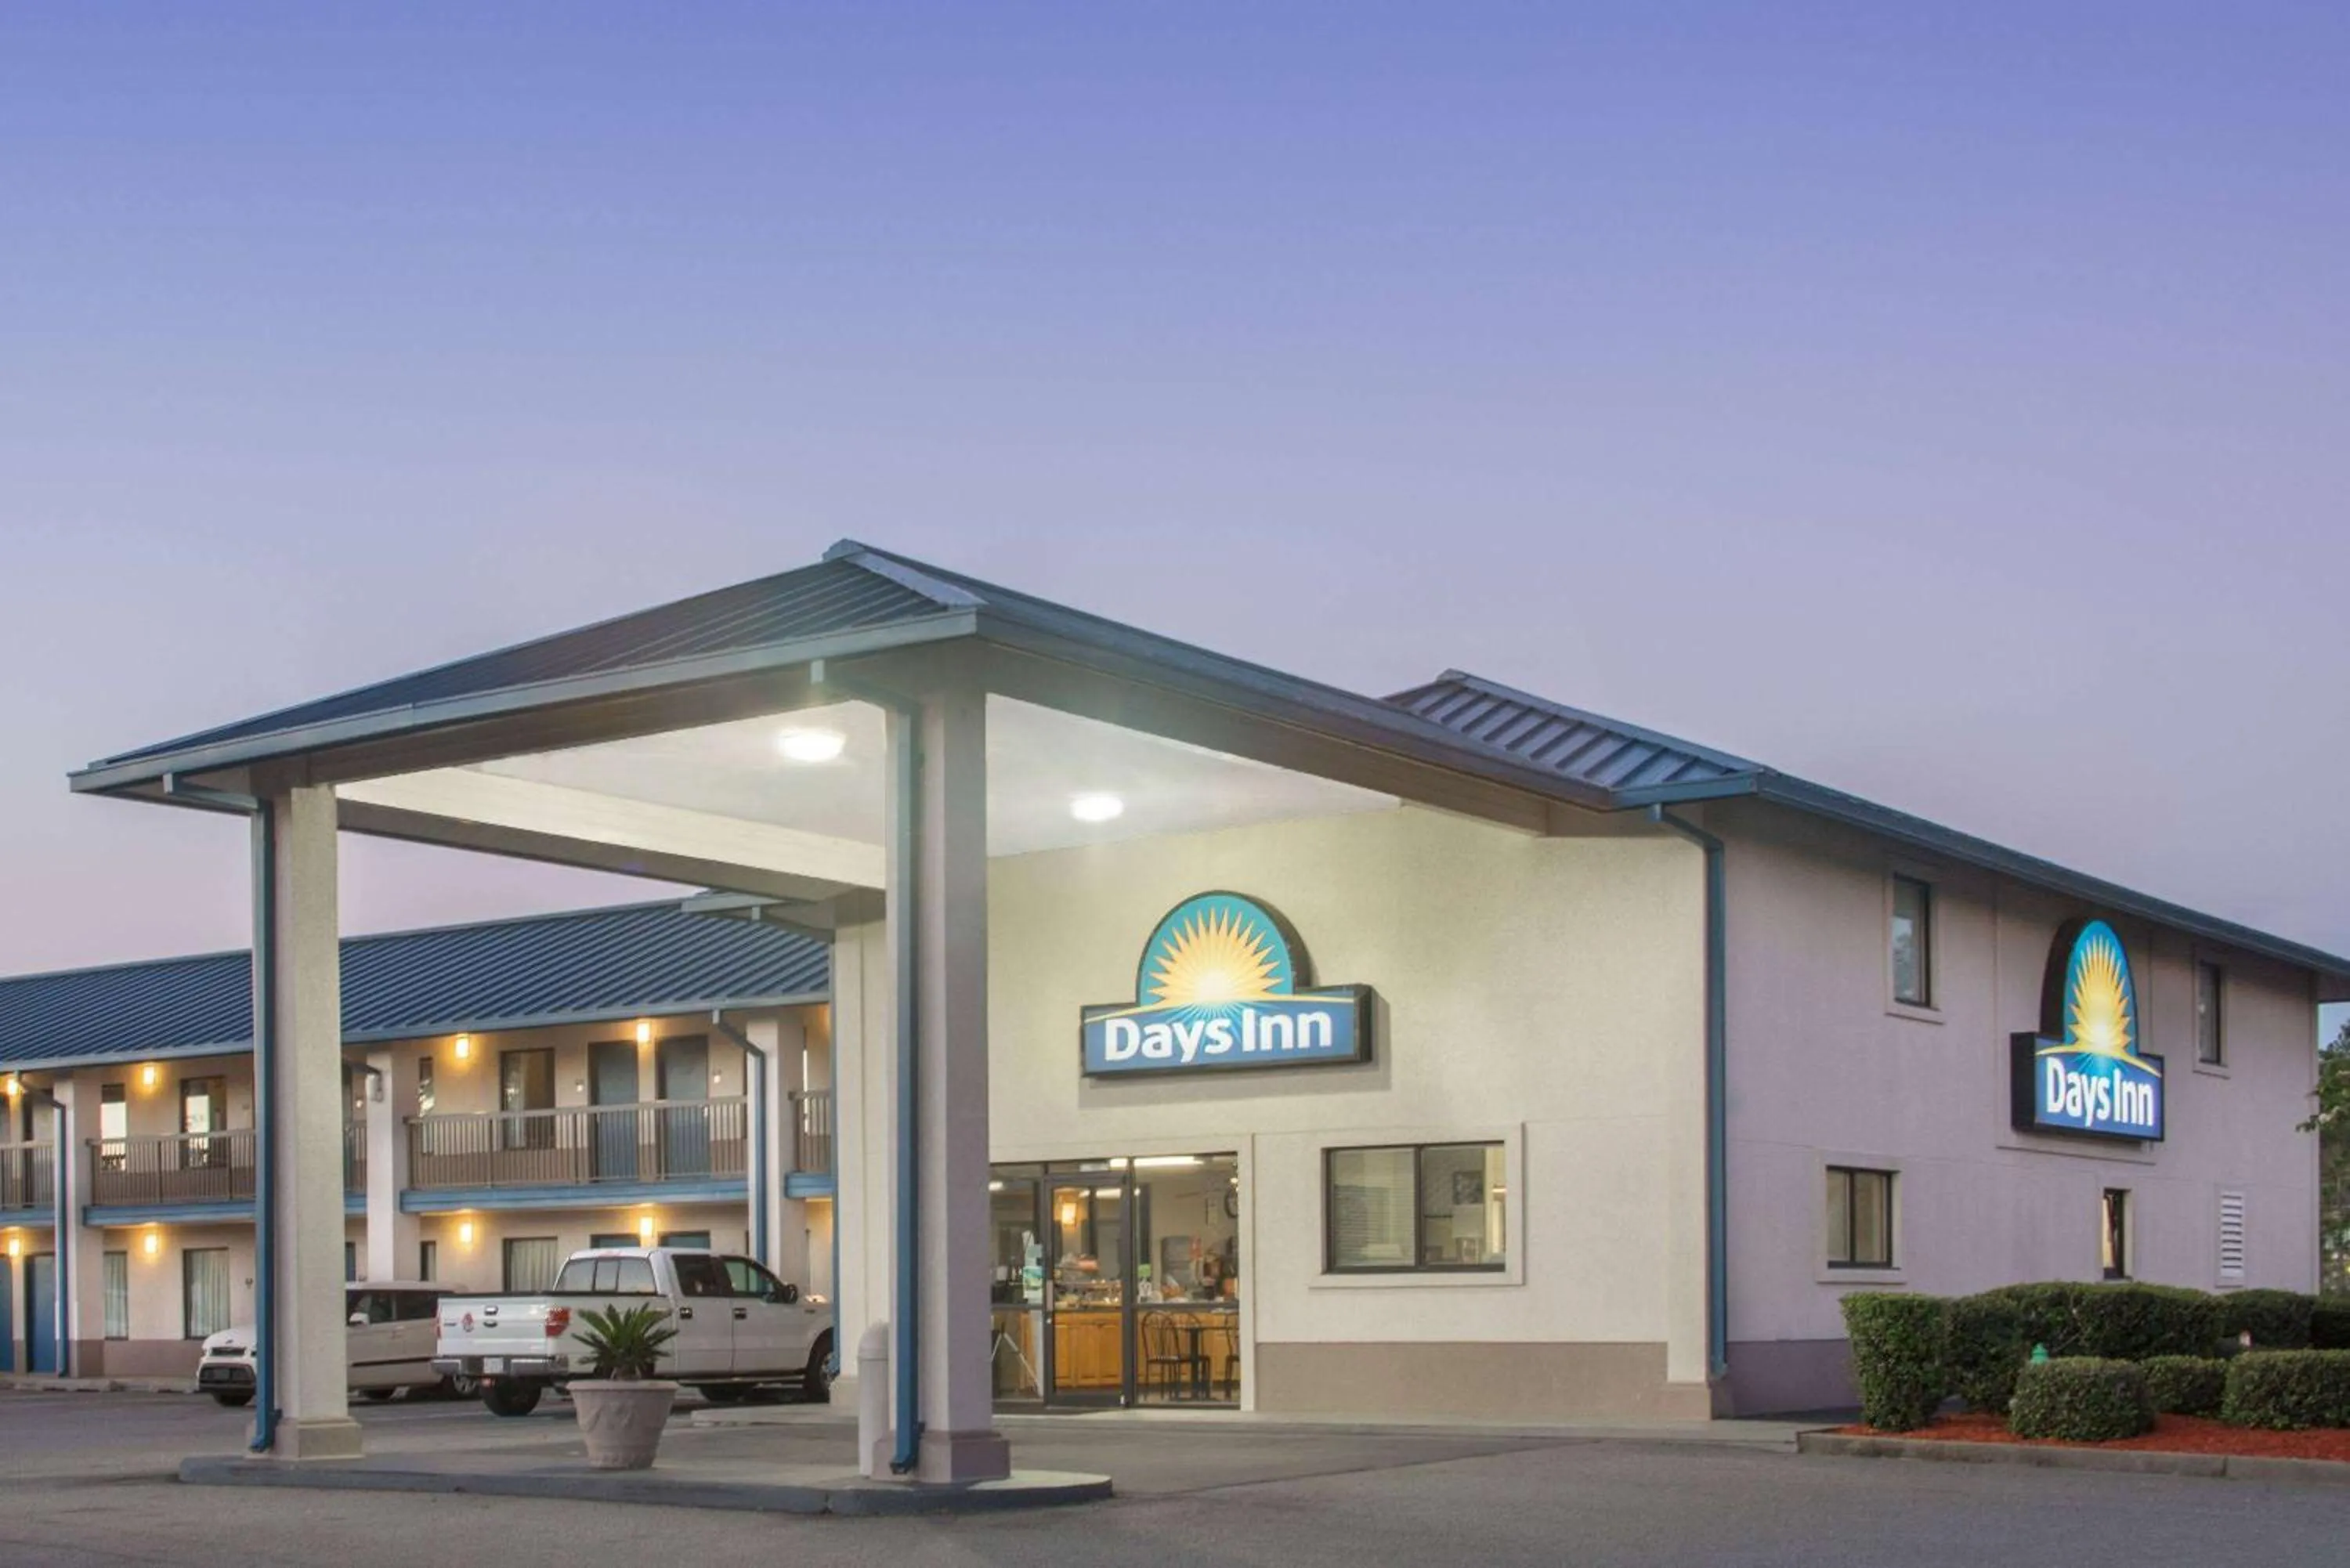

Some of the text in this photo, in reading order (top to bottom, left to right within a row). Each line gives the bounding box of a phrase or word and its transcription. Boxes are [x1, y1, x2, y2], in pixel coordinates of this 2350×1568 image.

[1104, 1009, 1332, 1063] Days Inn
[2046, 1057, 2153, 1127] Days Inn
